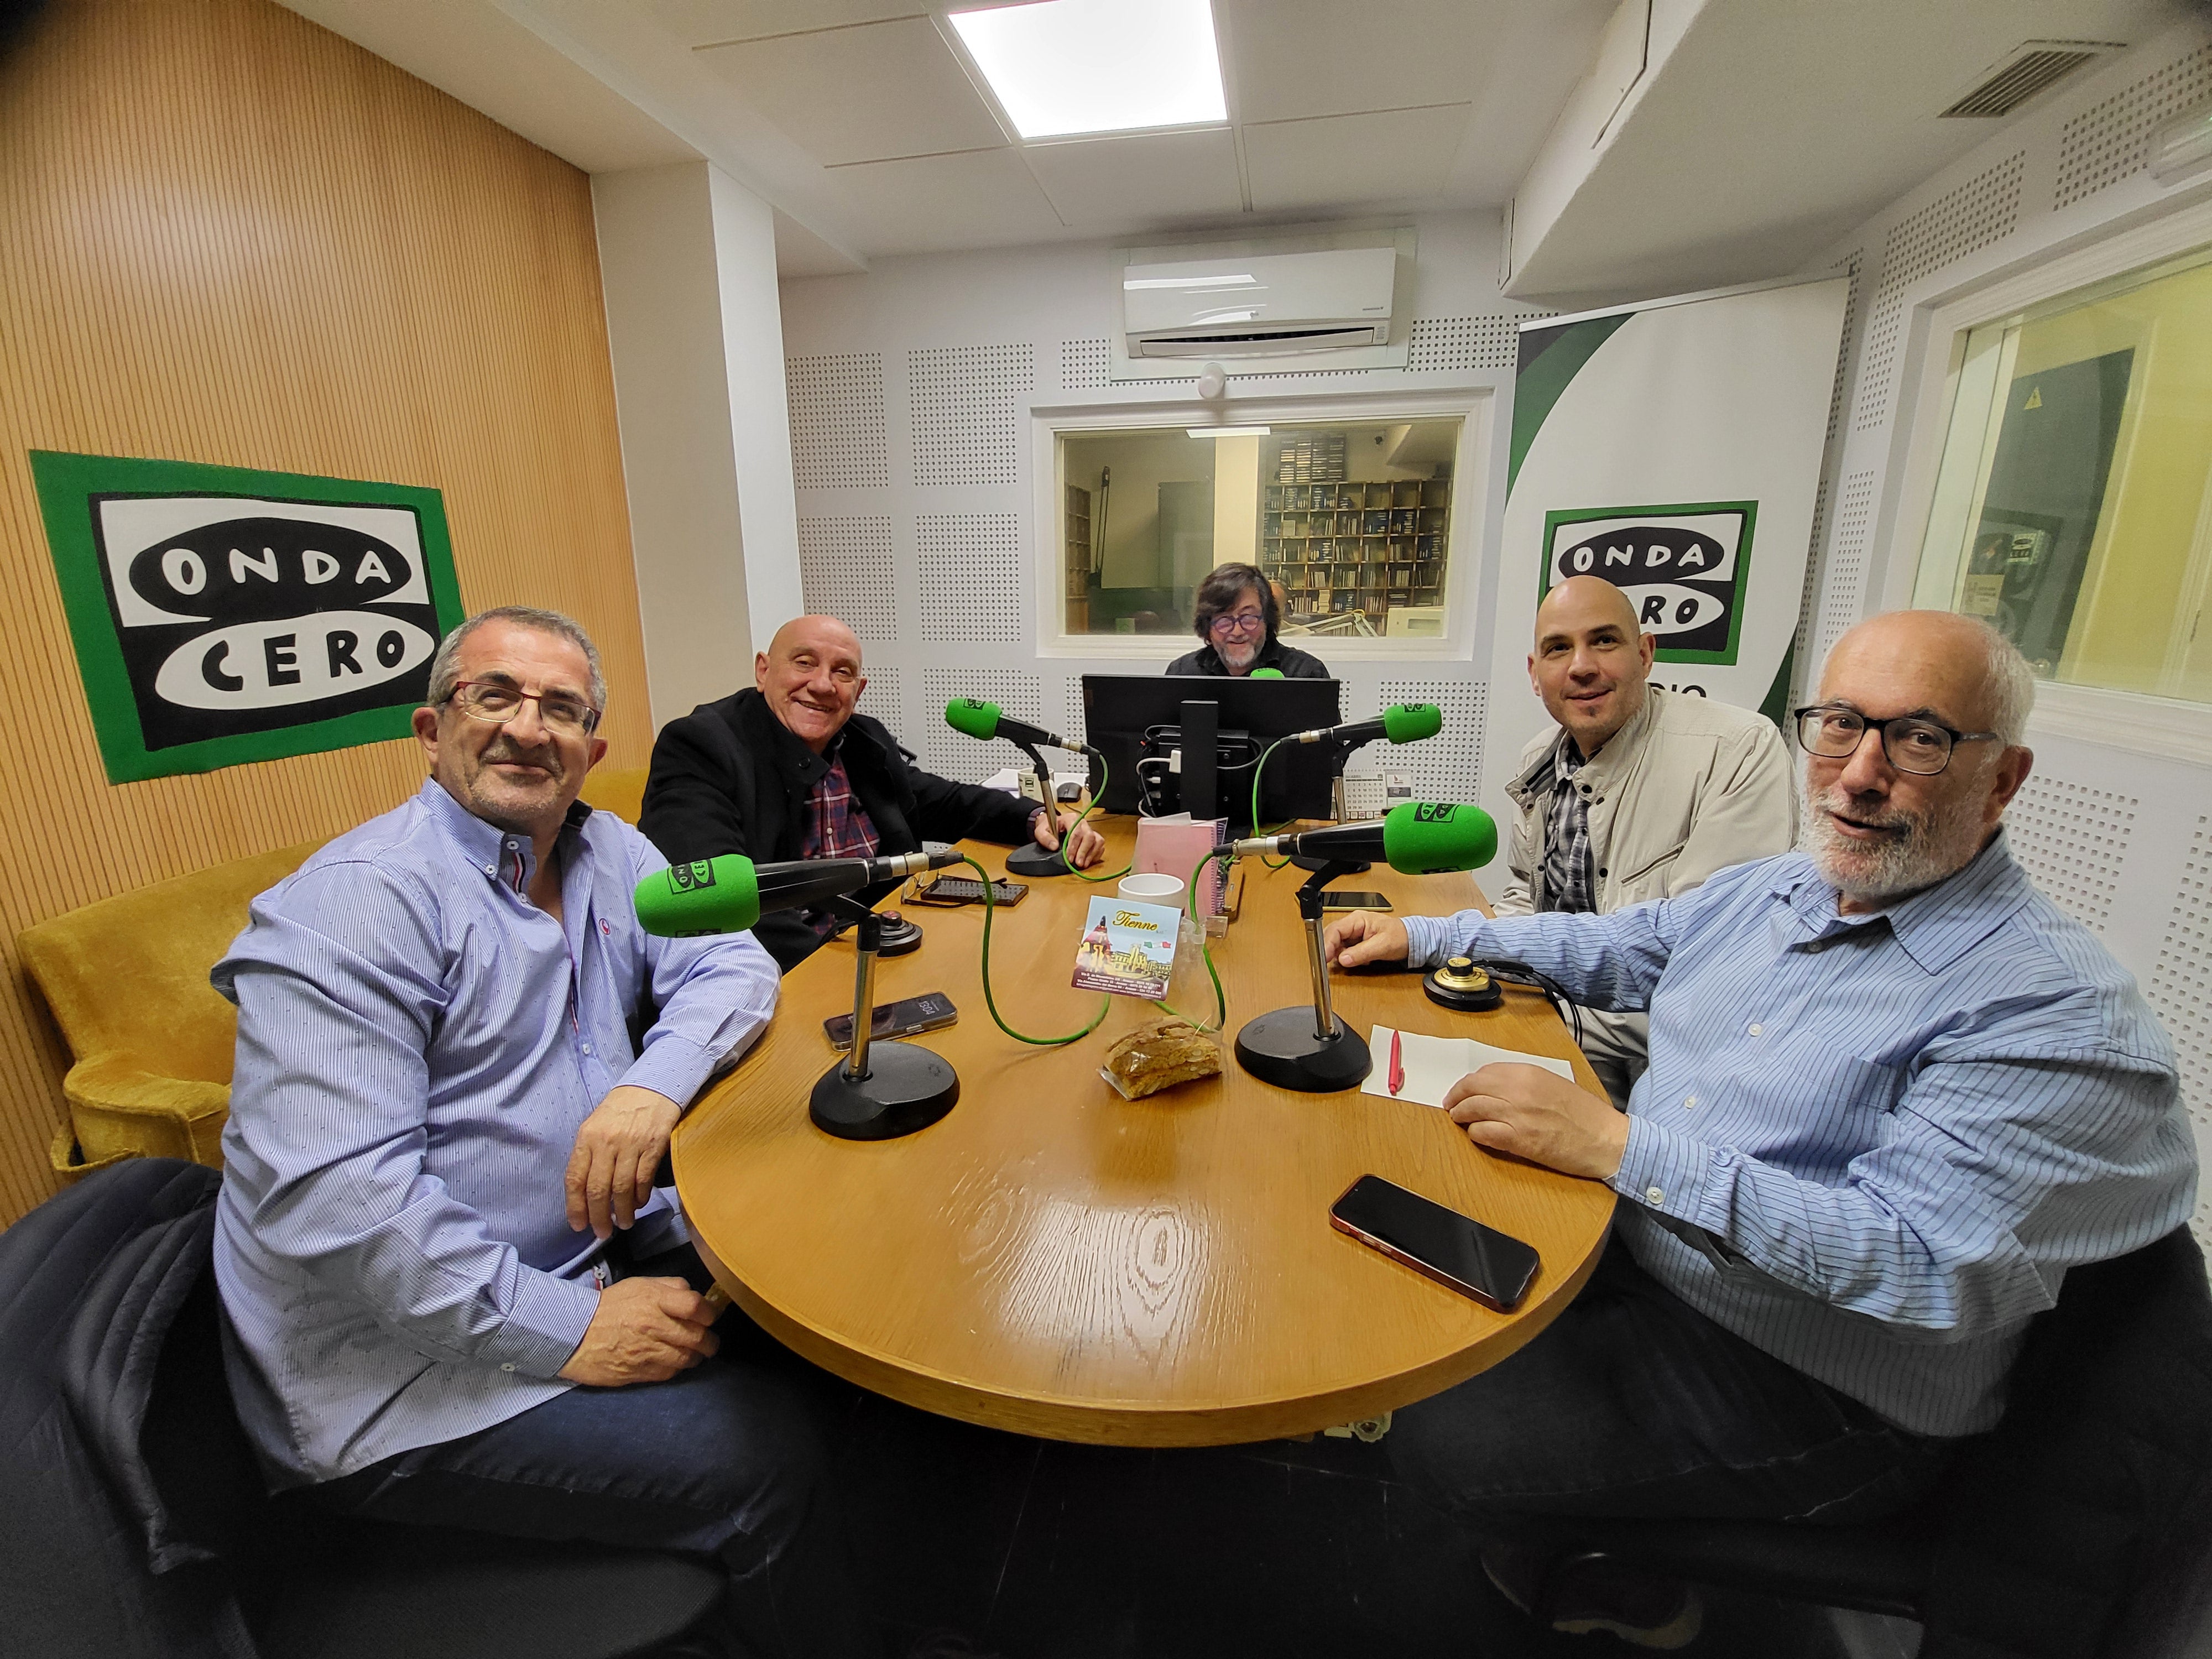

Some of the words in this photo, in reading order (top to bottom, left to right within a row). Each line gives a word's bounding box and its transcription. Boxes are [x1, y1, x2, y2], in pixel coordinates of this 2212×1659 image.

[161, 546, 392, 596] ONDA
[1573, 543, 1705, 572] ONDA
[1640, 595, 1699, 625] RO
[201, 629, 406, 692] CERO
[677, 864, 688, 883] ON
[1113, 910, 1158, 931] Tienne
